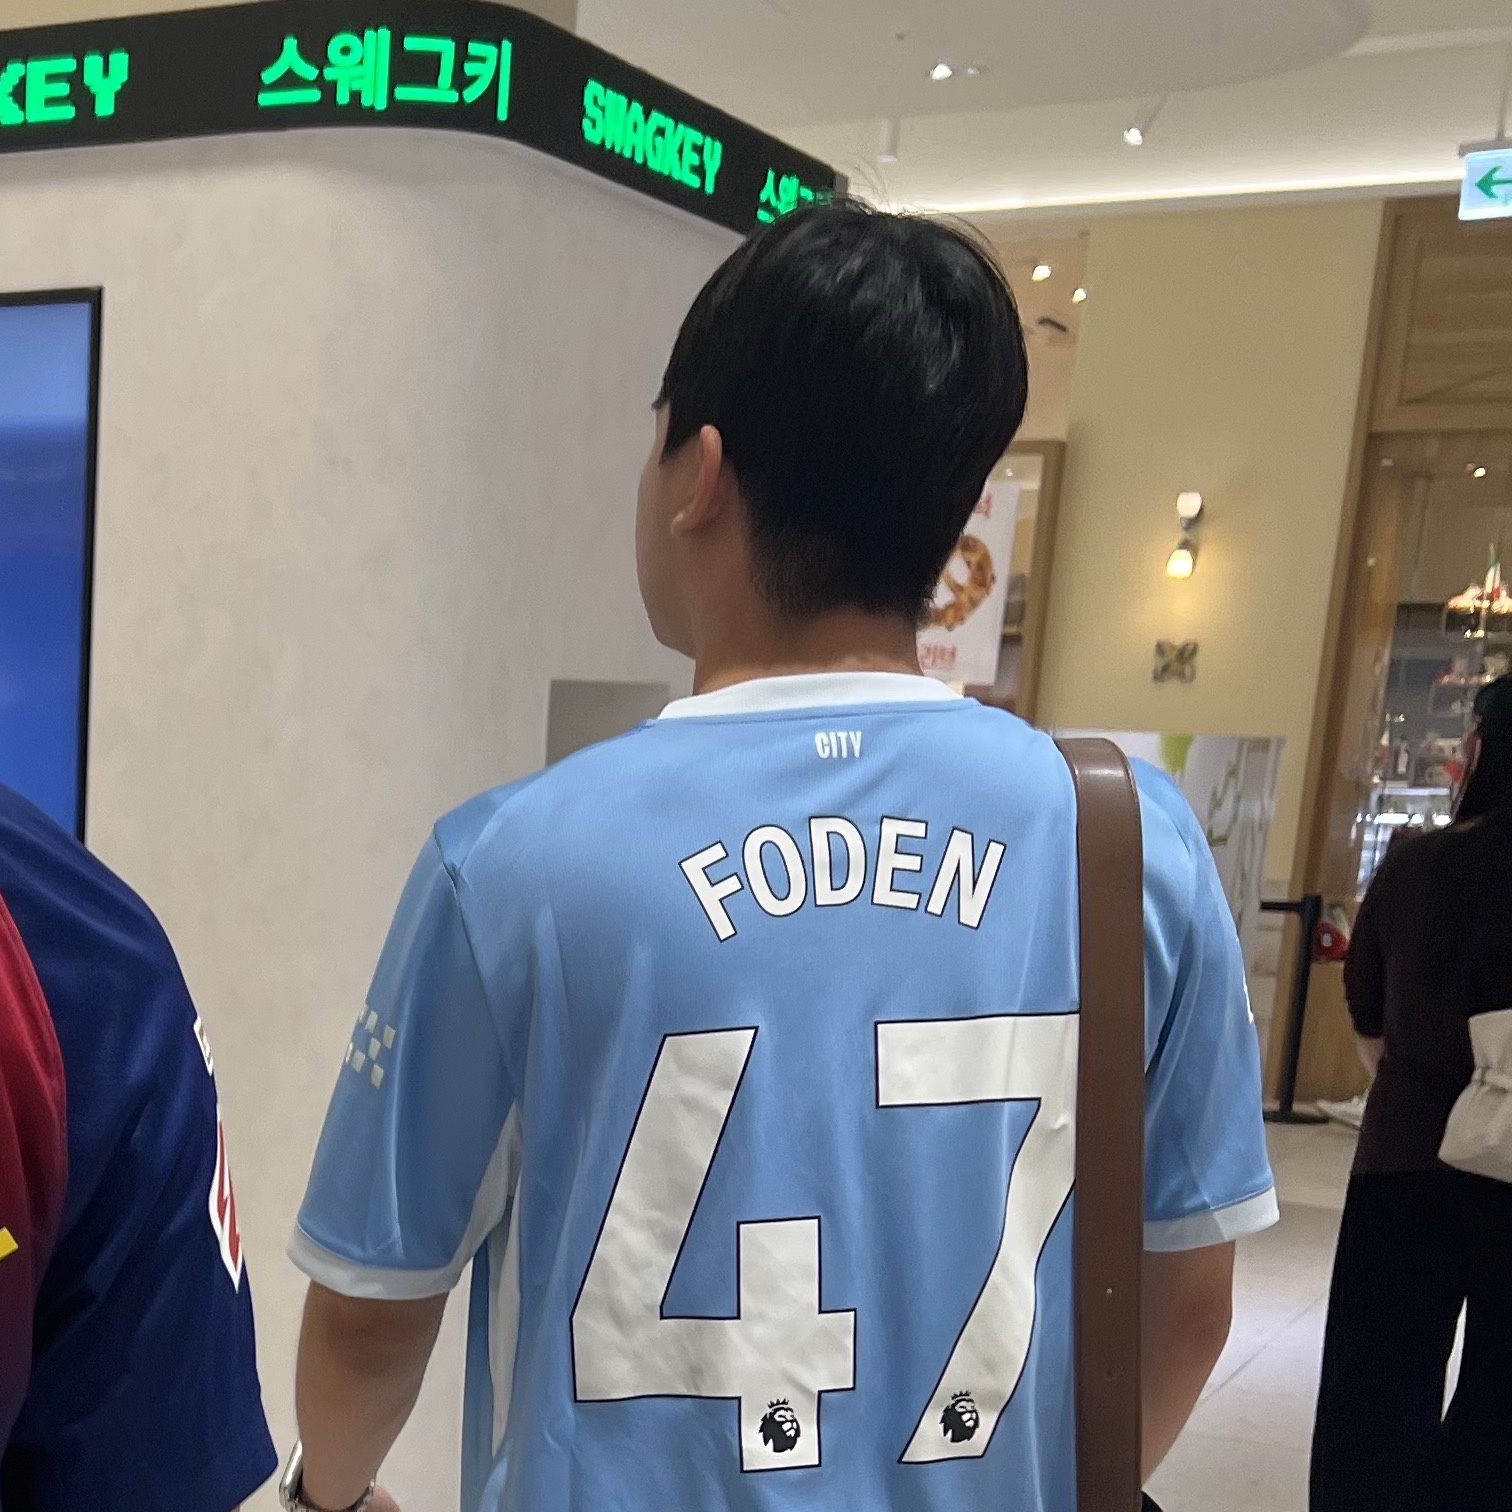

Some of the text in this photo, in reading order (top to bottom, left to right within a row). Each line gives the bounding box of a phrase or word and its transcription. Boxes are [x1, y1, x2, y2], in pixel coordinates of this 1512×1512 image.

[258, 27, 513, 122] 스웨그키
[582, 78, 723, 195] SWAGKEY
[814, 730, 863, 759] CITY
[678, 815, 1007, 943] FODEN
[571, 1012, 1080, 1473] 47
